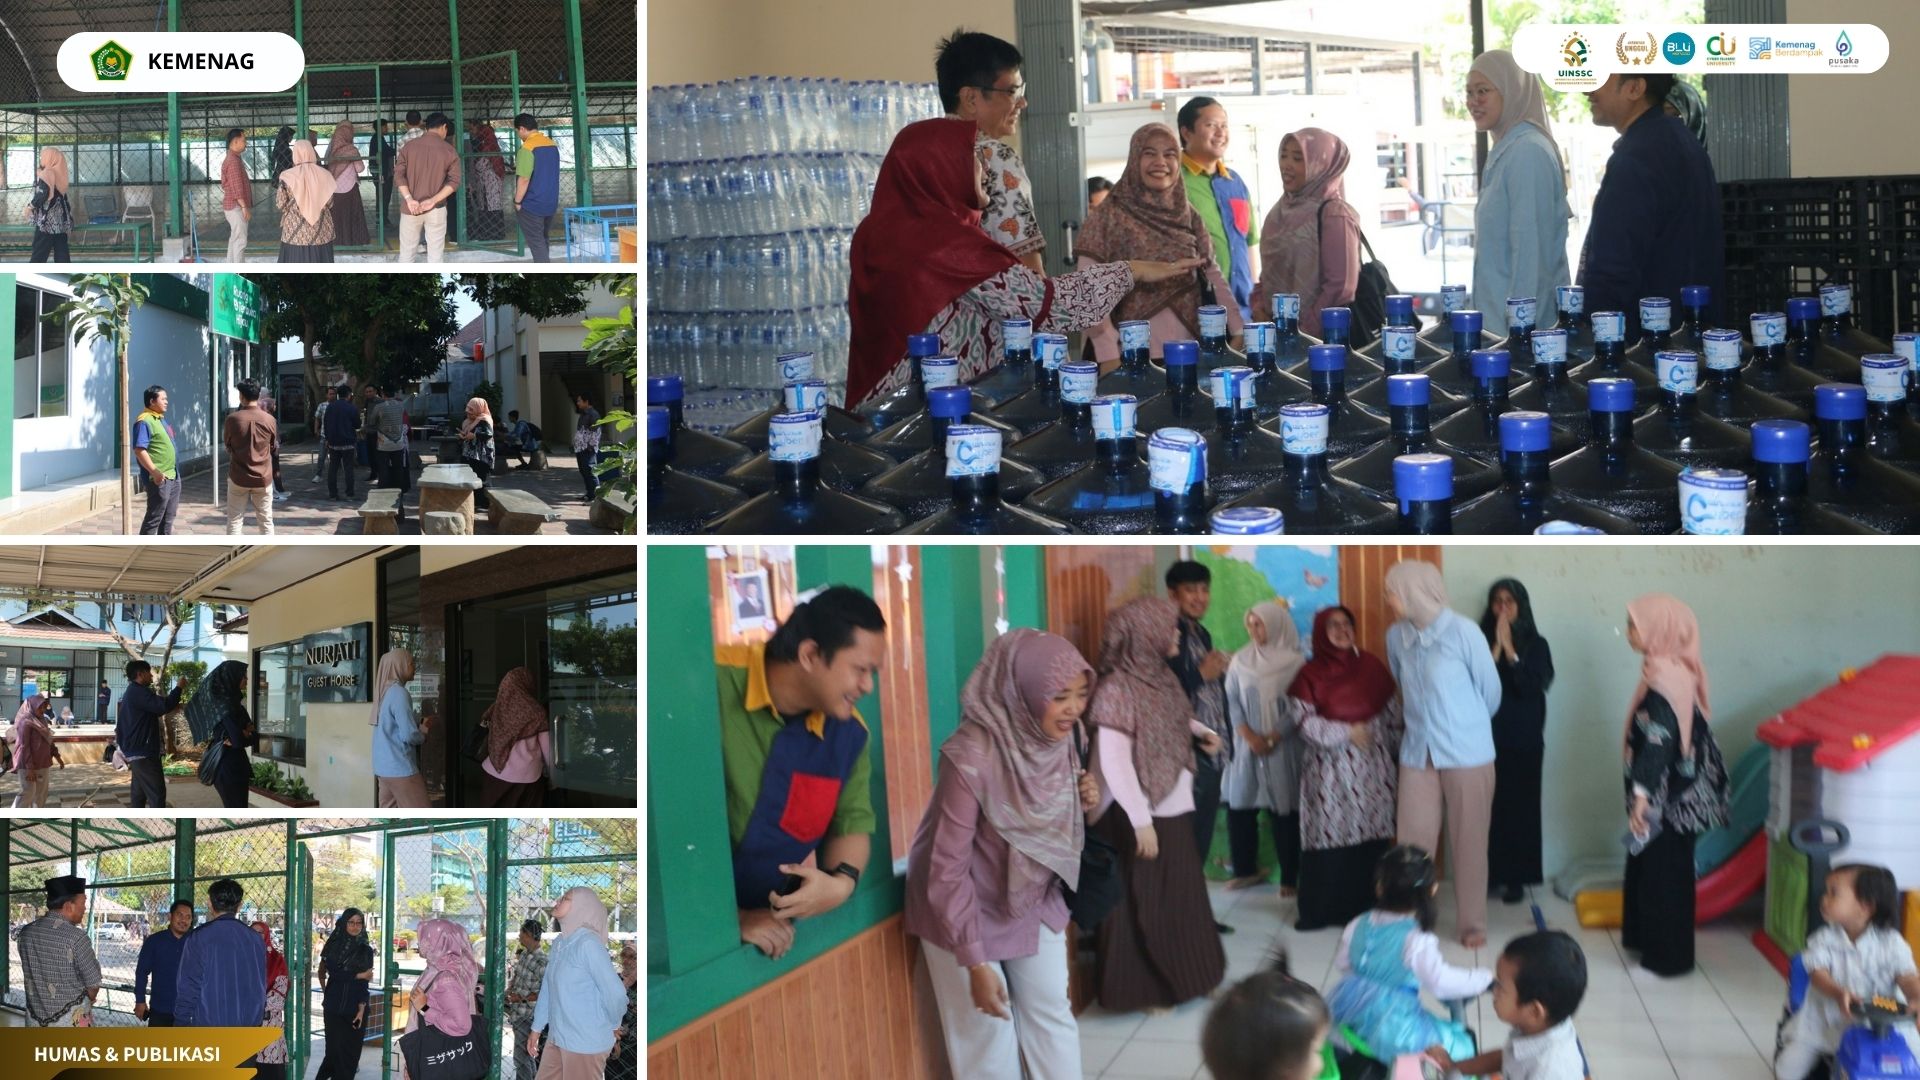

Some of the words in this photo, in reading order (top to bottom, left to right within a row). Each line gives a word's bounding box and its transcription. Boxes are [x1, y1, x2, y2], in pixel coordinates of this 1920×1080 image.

[305, 639, 357, 667] NURJATI
[307, 675, 328, 688] GUEST
[330, 674, 356, 687] HOUSE
